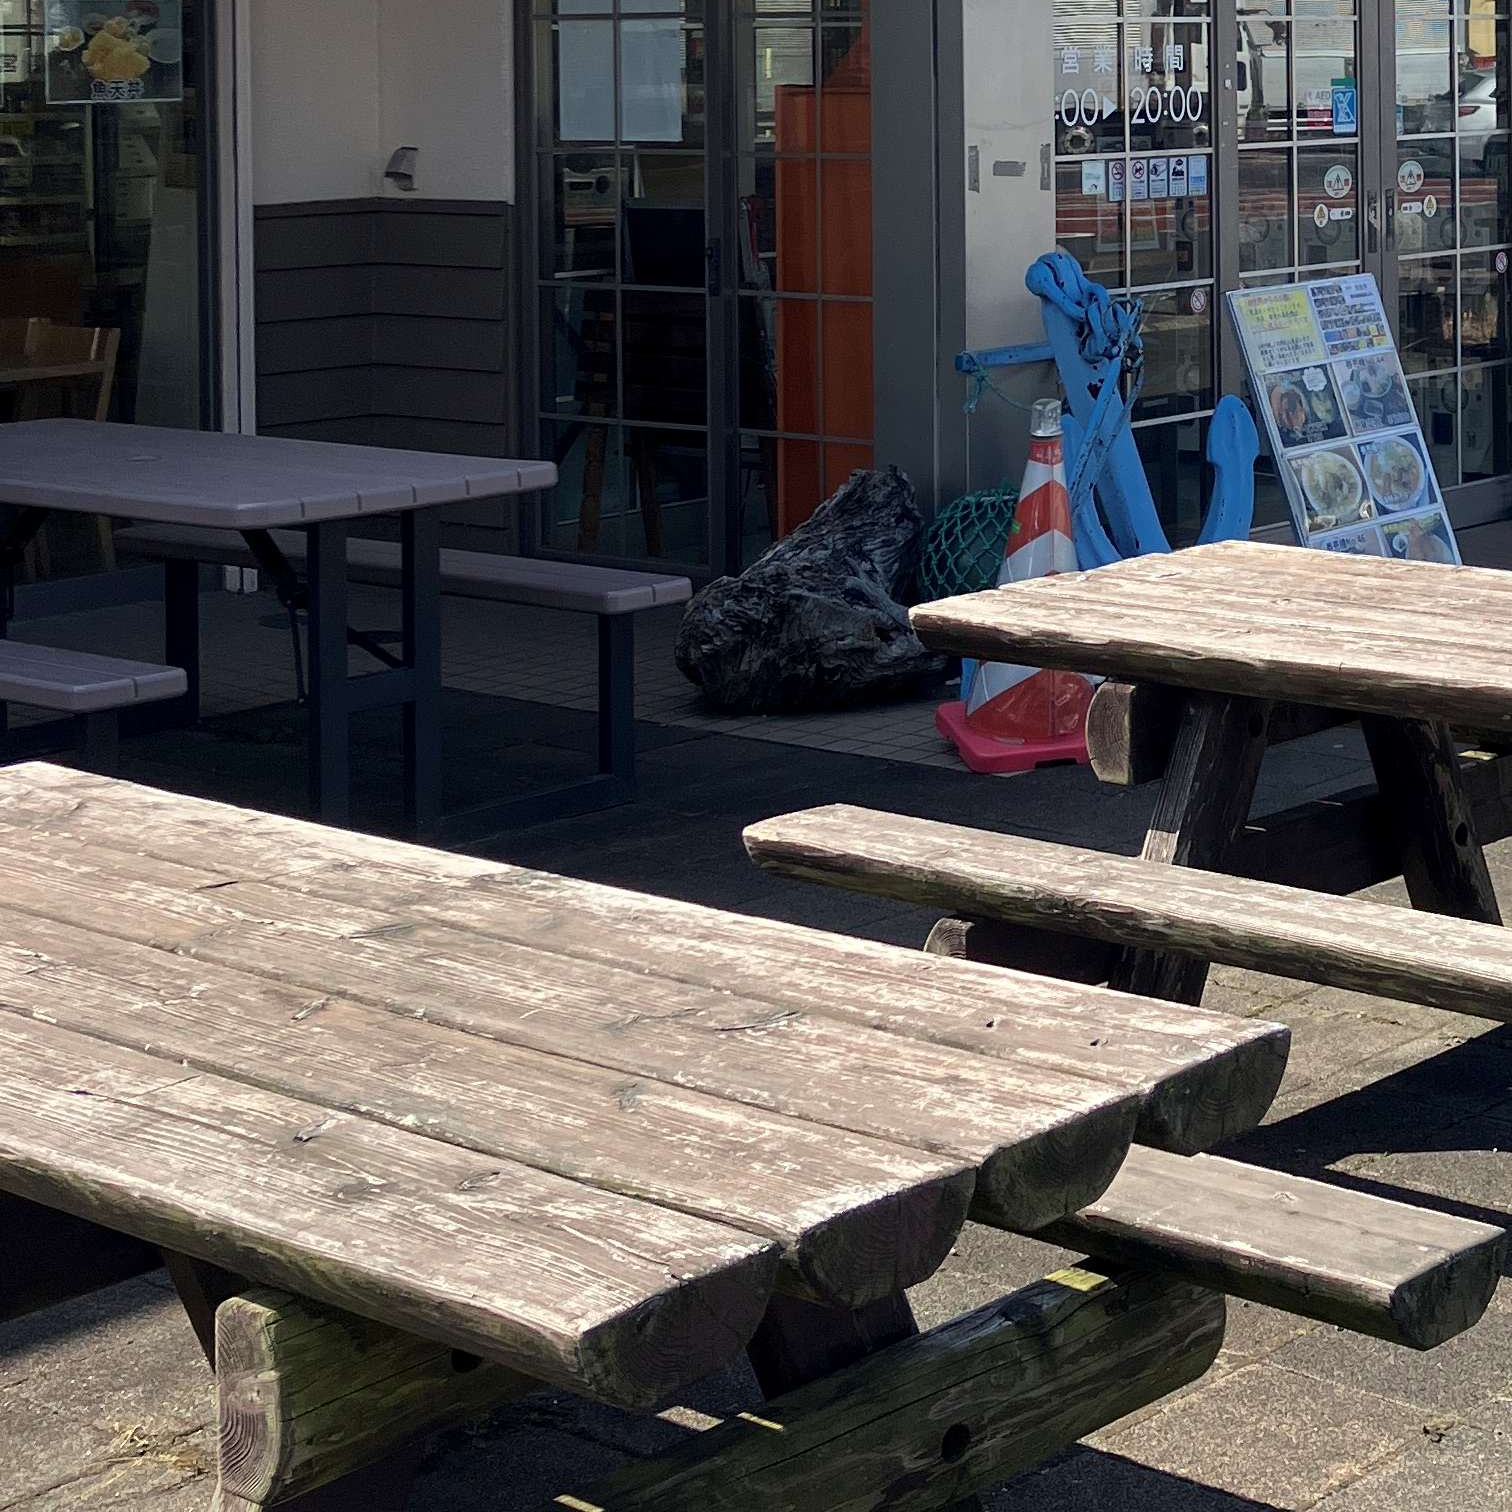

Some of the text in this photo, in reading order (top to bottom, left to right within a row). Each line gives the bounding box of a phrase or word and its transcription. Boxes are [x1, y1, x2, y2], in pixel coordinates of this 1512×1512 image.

[1061, 45, 1184, 74] 営業時間
[1130, 85, 1203, 125] 20:00
